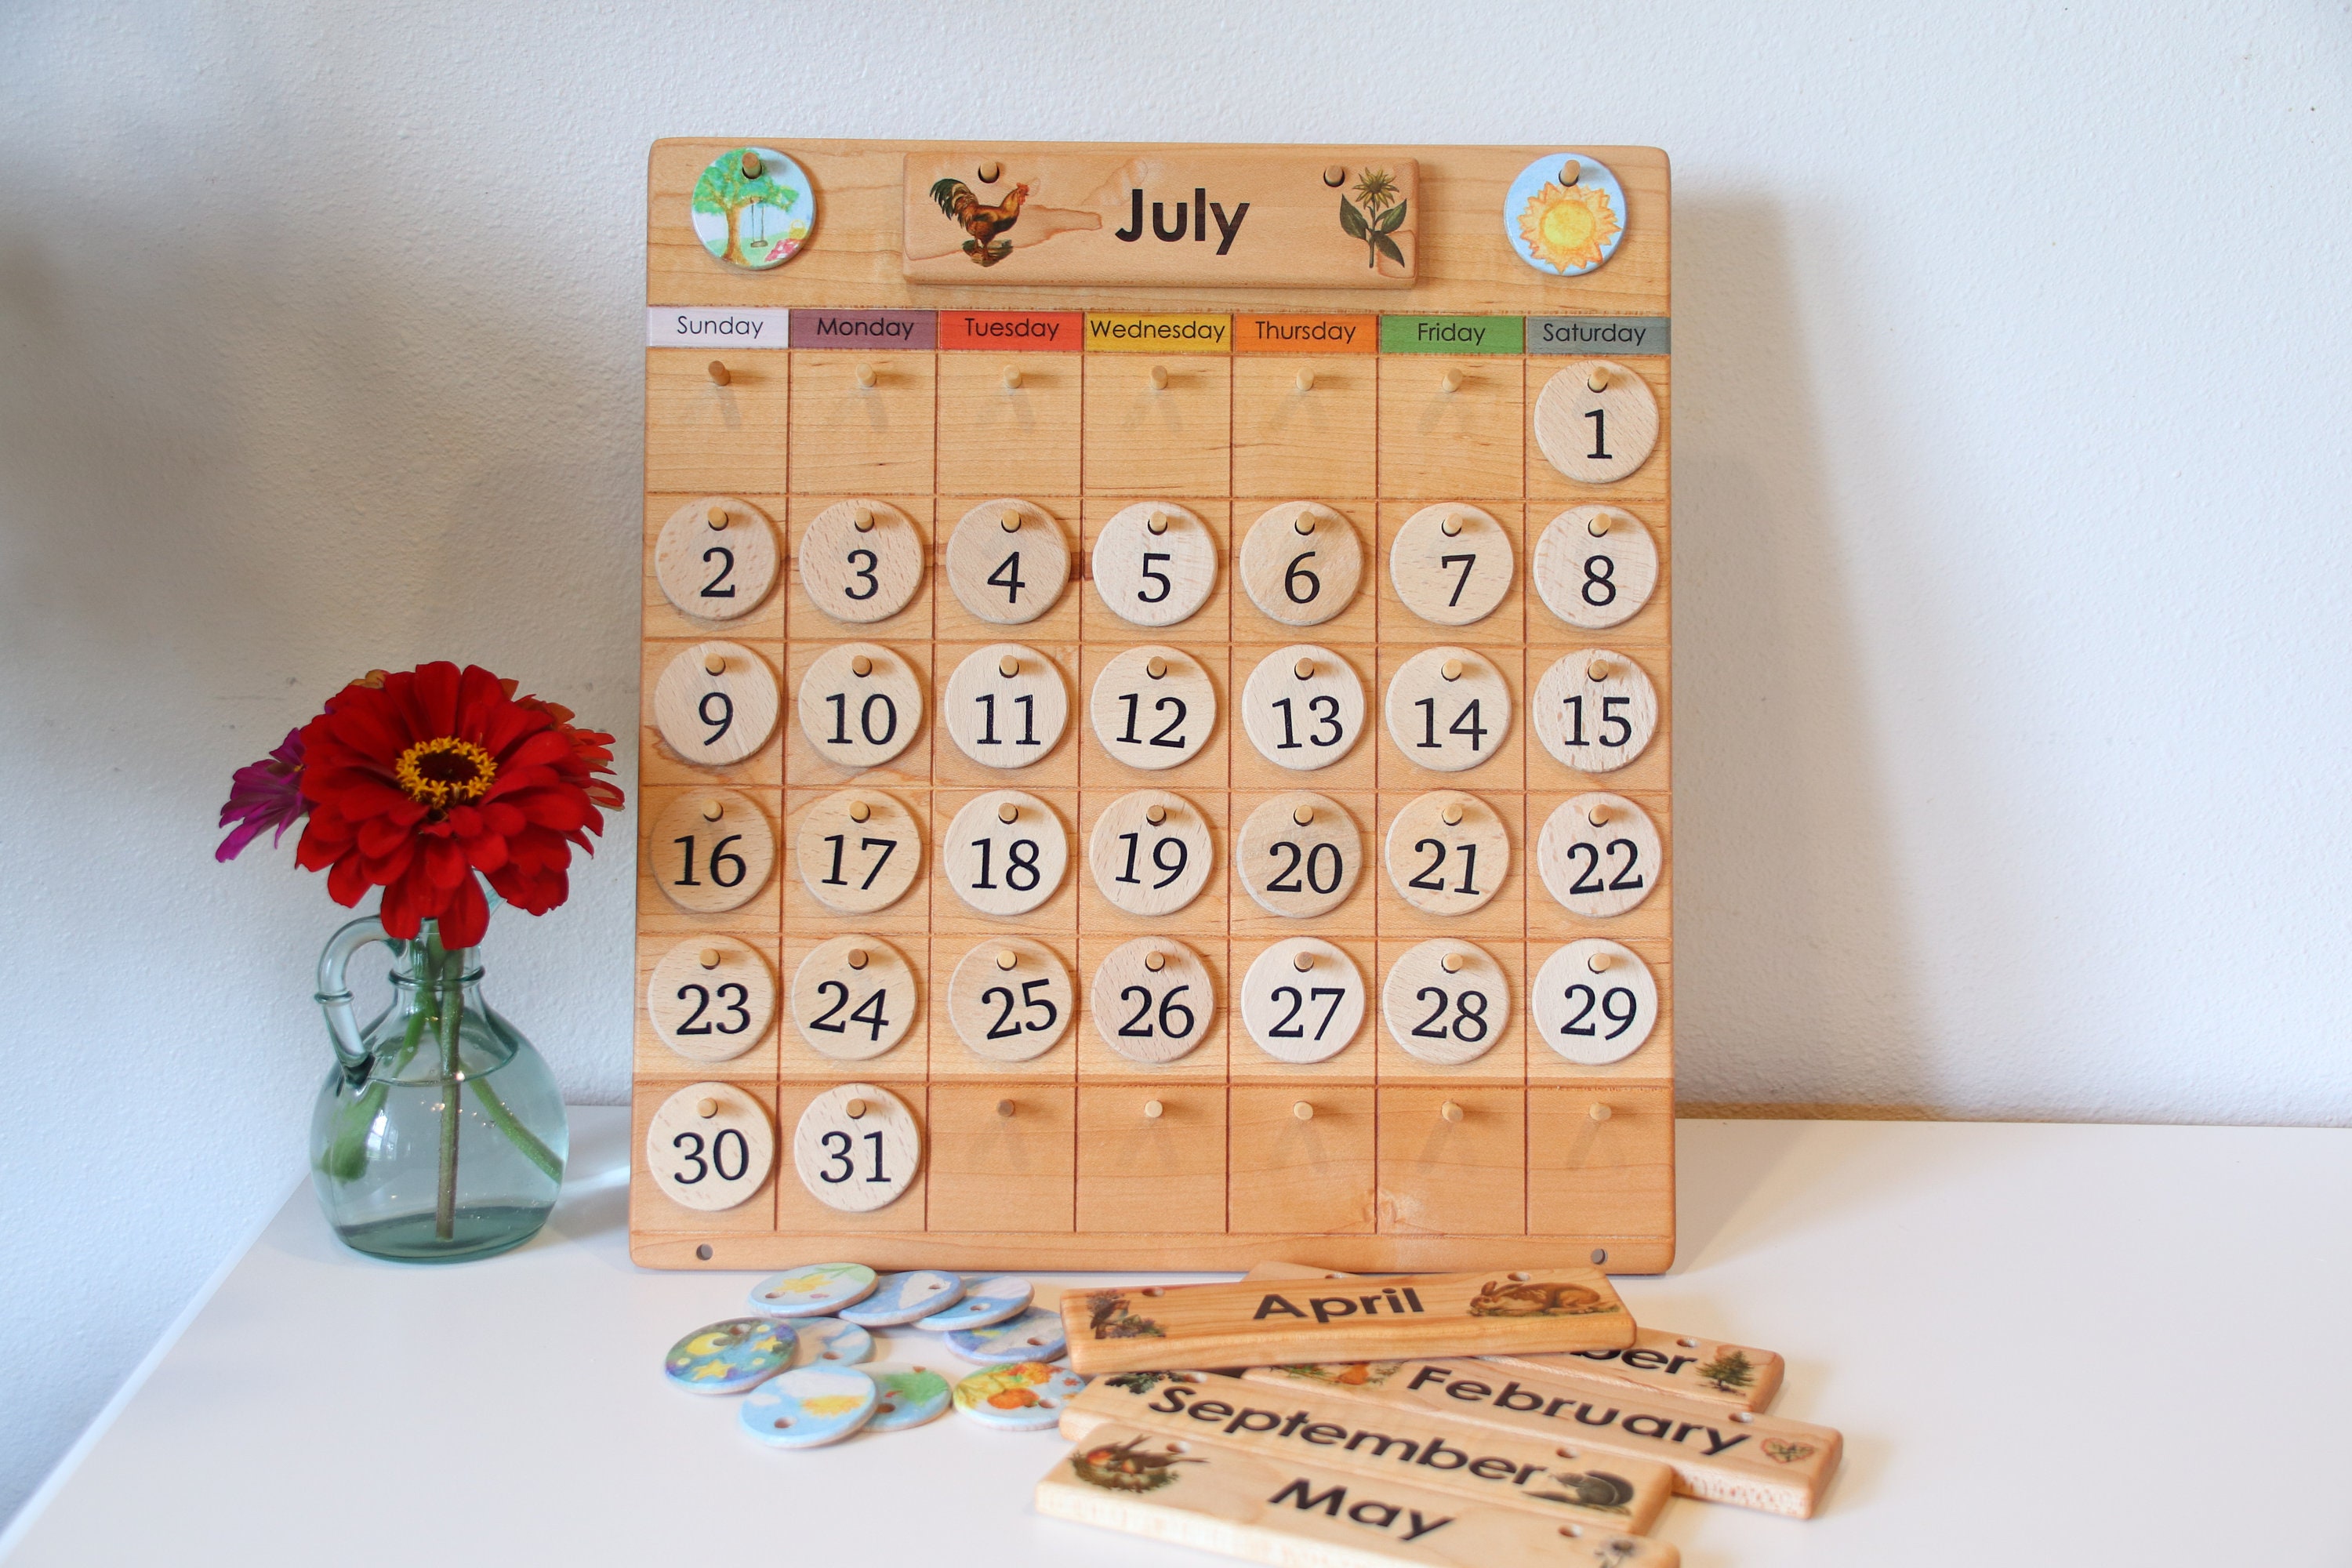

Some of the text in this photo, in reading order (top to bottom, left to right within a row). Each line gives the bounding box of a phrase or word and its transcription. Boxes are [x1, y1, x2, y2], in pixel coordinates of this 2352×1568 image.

[1114, 187, 1251, 256] July
[677, 315, 763, 339] Sunday
[817, 317, 915, 341] Monday
[964, 318, 1060, 343] Tuesday
[1091, 320, 1225, 343] Wednesday
[1255, 321, 1356, 344] Thursday
[1418, 322, 1486, 347] Friday
[1542, 322, 1647, 347] Saturday
[1584, 408, 1613, 459] 1
[700, 546, 735, 598] 2
[844, 549, 879, 601] 3
[986, 551, 1025, 604] 4
[1138, 553, 1171, 603] 5
[1284, 551, 1320, 604] 6
[1441, 554, 1476, 607] 7
[1581, 554, 1617, 607] 8
[699, 691, 733, 746] 9
[826, 693, 897, 746] 10
[975, 694, 1041, 746] 11
[1116, 693, 1187, 749] 12
[1272, 695, 1343, 749] 13
[1414, 697, 1488, 751] 14
[1563, 695, 1632, 747] 15
[673, 834, 746, 887] 16
[822, 834, 898, 891] 17
[971, 837, 1040, 891] 18
[1115, 833, 1188, 890] 19
[1266, 841, 1343, 895] 20
[1408, 838, 1479, 895] 21
[1566, 838, 1643, 895] 22
[676, 982, 750, 1036] 23
[809, 981, 889, 1041] 24
[982, 978, 1058, 1040] 25
[1118, 985, 1195, 1039] 26
[1269, 986, 1345, 1040] 27
[1411, 986, 1487, 1043] 28
[1560, 984, 1637, 1040] 29
[673, 1129, 749, 1185] 30
[820, 1131, 891, 1183] 31
[1253, 1287, 1425, 1323] April
[1148, 1385, 1547, 1485] September
[1407, 1364, 1752, 1457] February
[1267, 1477, 1456, 1542] May
